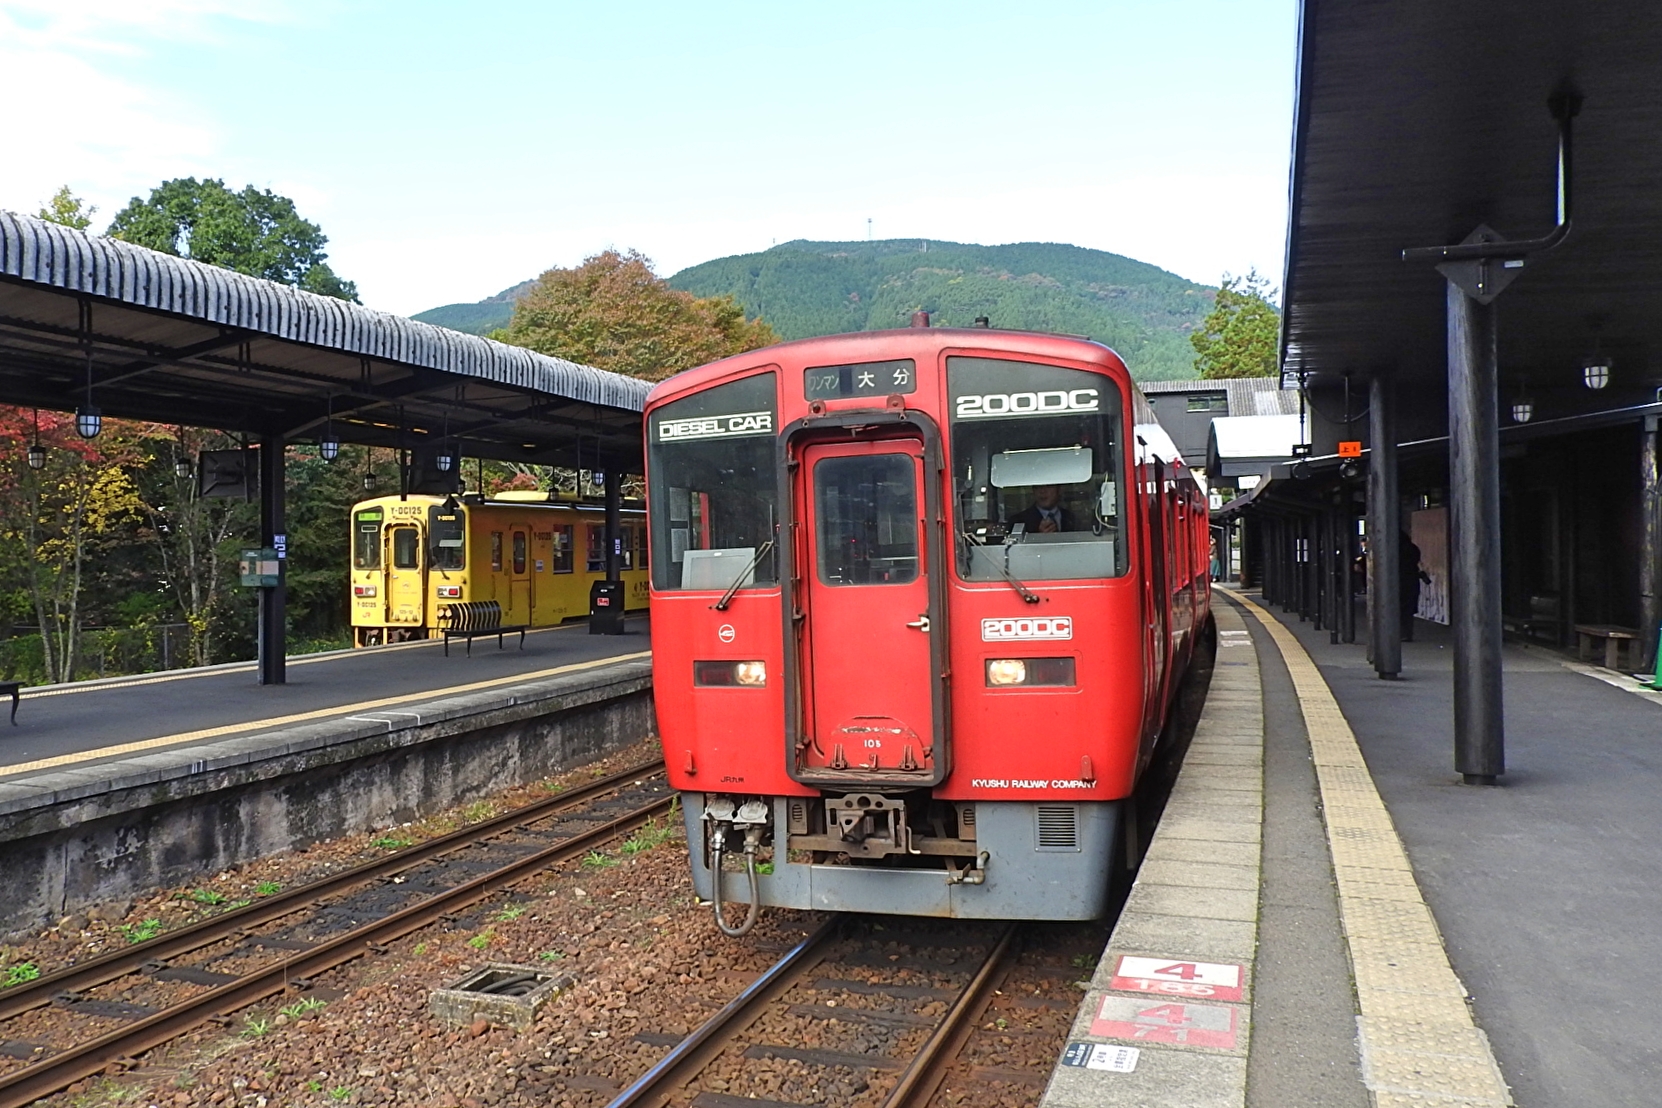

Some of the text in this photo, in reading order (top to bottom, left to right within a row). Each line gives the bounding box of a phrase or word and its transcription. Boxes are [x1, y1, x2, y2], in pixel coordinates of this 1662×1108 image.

[809, 375, 840, 391] ワンマン
[956, 389, 1099, 414] 200DC
[659, 415, 772, 438] DIESEL CAR
[390, 506, 422, 515] Y-DC125
[984, 619, 1070, 636] 200DC
[864, 739, 882, 748] 105
[972, 779, 1097, 788] KYUSHU RAILWAY COMPANY
[1154, 963, 1203, 980] 4
[1134, 979, 1216, 996] 185
[1138, 1004, 1193, 1024] 4
